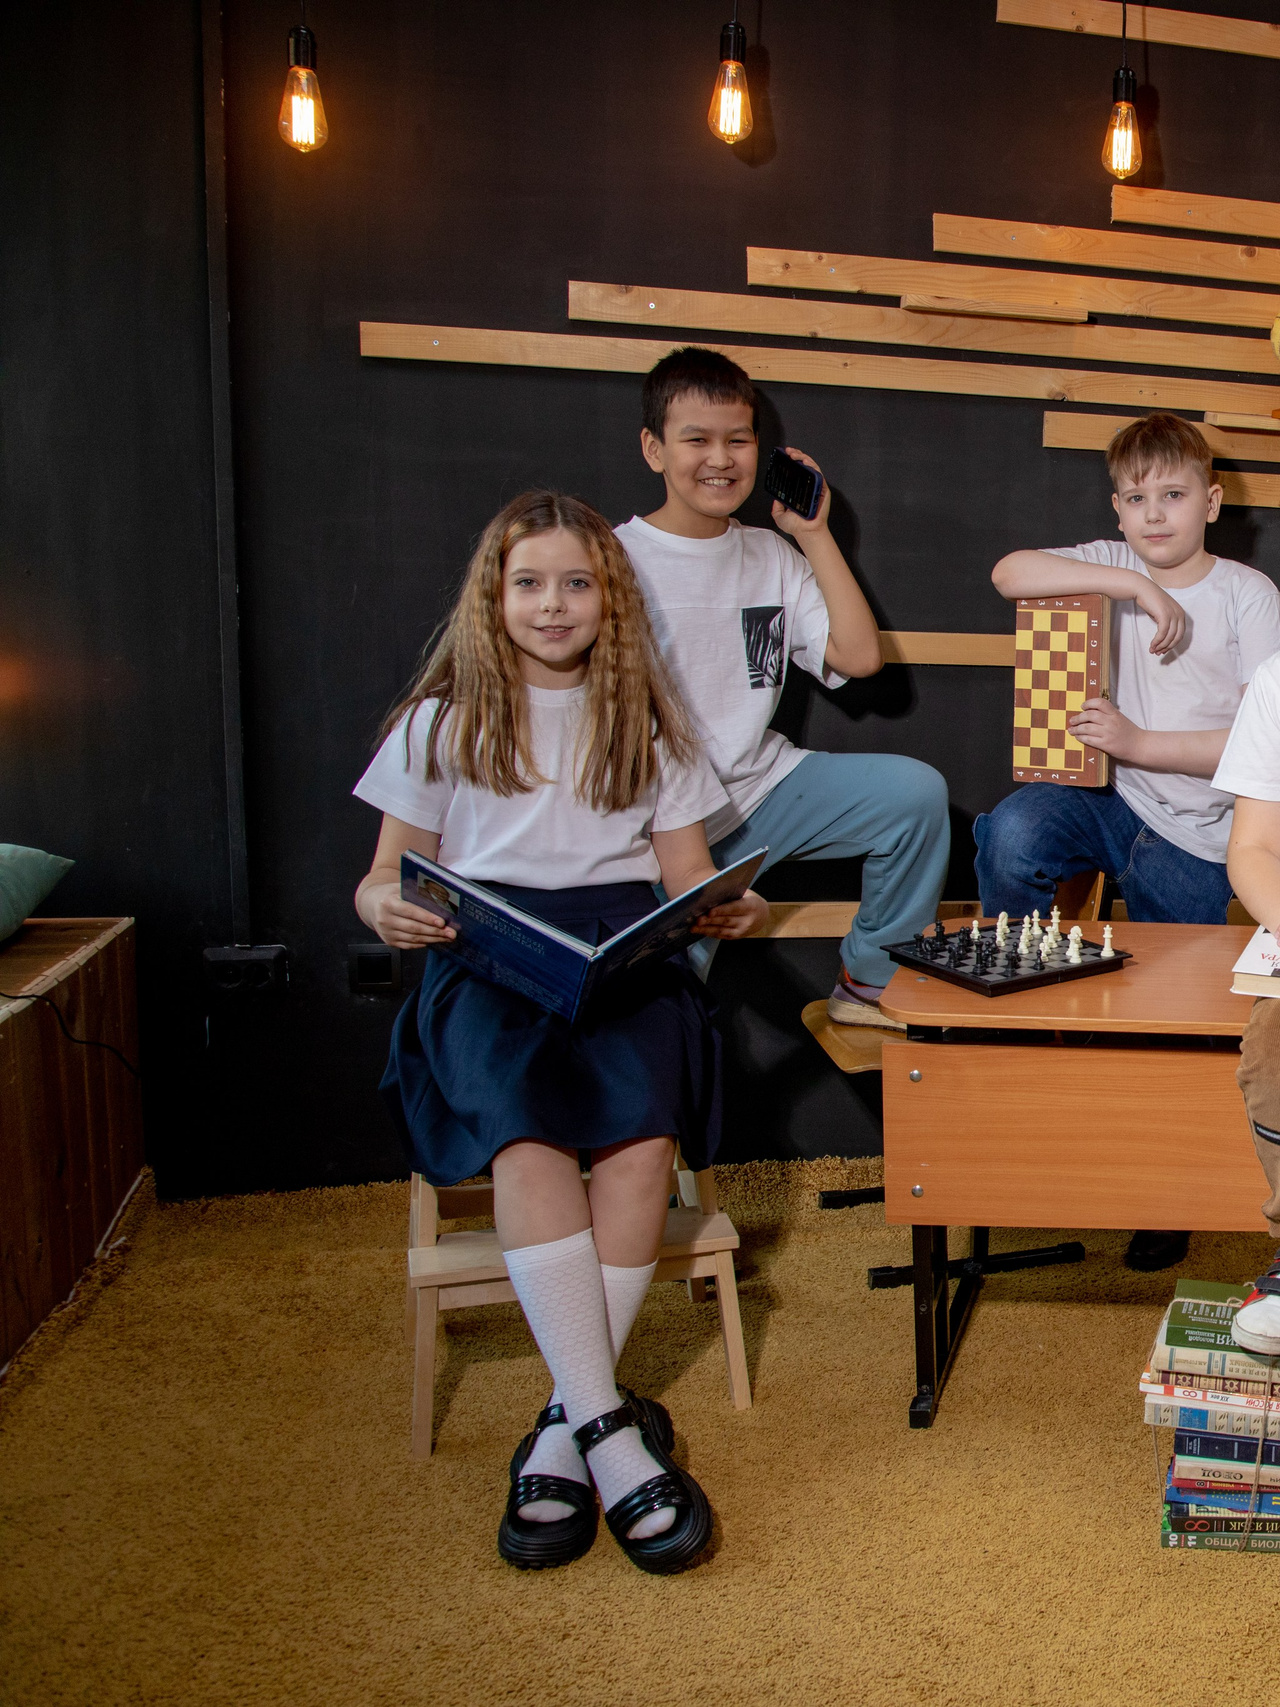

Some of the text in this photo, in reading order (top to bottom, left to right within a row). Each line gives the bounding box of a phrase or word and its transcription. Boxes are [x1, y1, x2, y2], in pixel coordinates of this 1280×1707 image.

[1228, 1367, 1272, 1378] ОРДЕЕВ
[1169, 1533, 1178, 1549] 10
[1187, 1534, 1197, 1548] 11
[1204, 1536, 1247, 1548] ОБЩА
